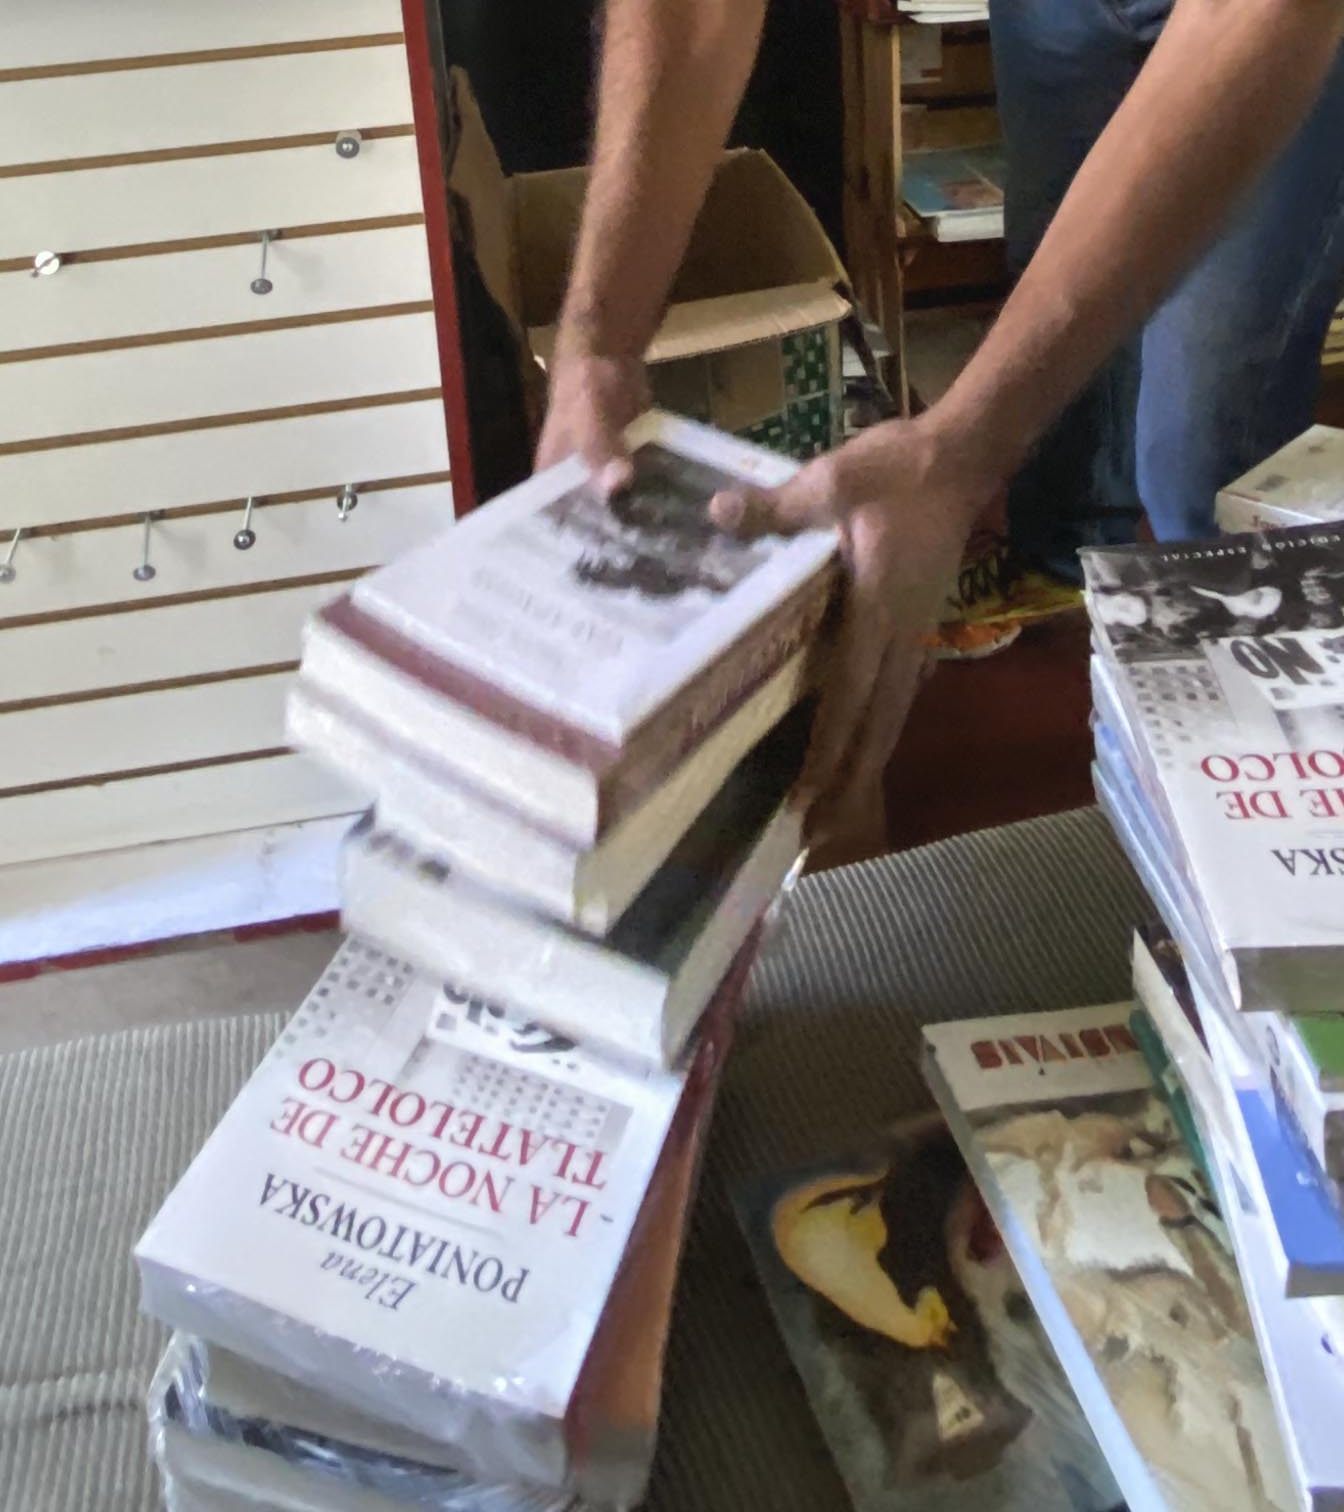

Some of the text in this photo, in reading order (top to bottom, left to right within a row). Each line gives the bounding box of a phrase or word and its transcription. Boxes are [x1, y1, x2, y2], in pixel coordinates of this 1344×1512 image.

[1217, 789, 1294, 821] DE
[269, 1096, 593, 1238] LA NOCHE DE
[297, 1055, 609, 1191] TLATELOLCO
[259, 1171, 531, 1304] PONIATOWSKA
[320, 1249, 419, 1311] Elena
